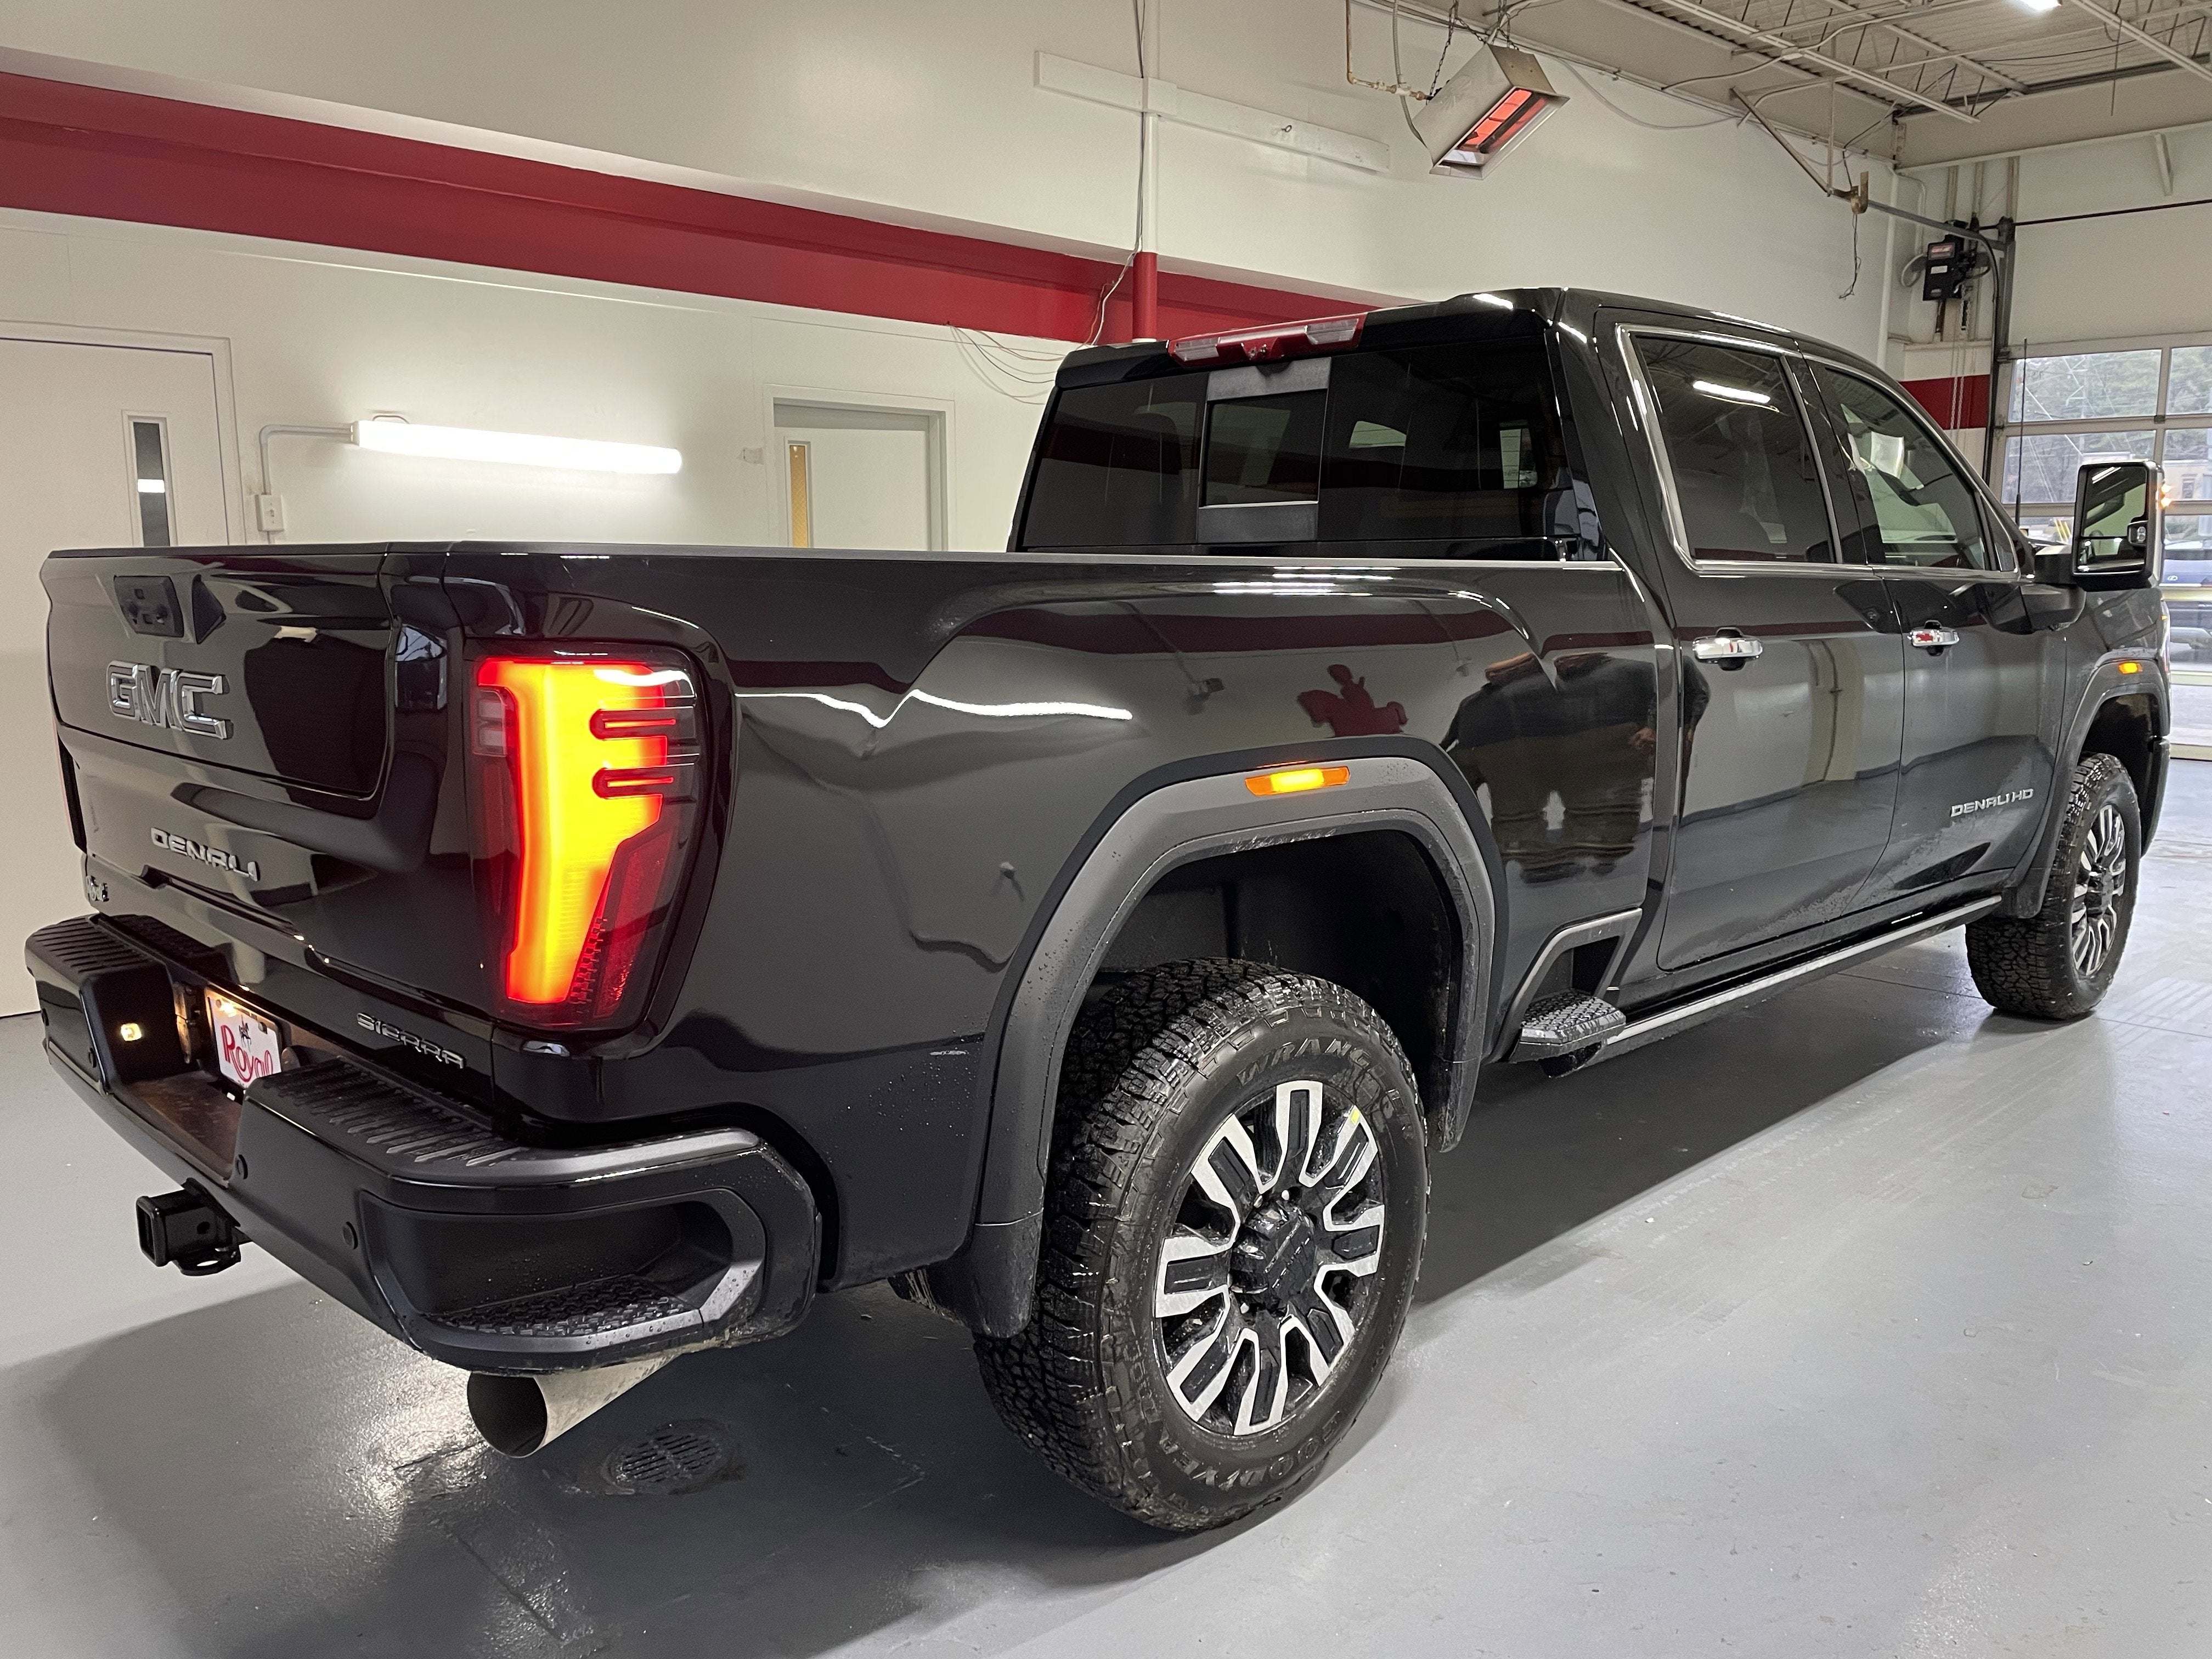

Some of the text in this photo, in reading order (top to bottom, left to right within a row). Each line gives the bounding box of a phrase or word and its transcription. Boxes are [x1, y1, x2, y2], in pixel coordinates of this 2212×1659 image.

[106, 660, 229, 740] GMC
[1950, 788, 2034, 817] DENALI HD
[151, 827, 259, 882] DENALI
[221, 1024, 274, 1082] Royal
[357, 1013, 465, 1069] SIERRA
